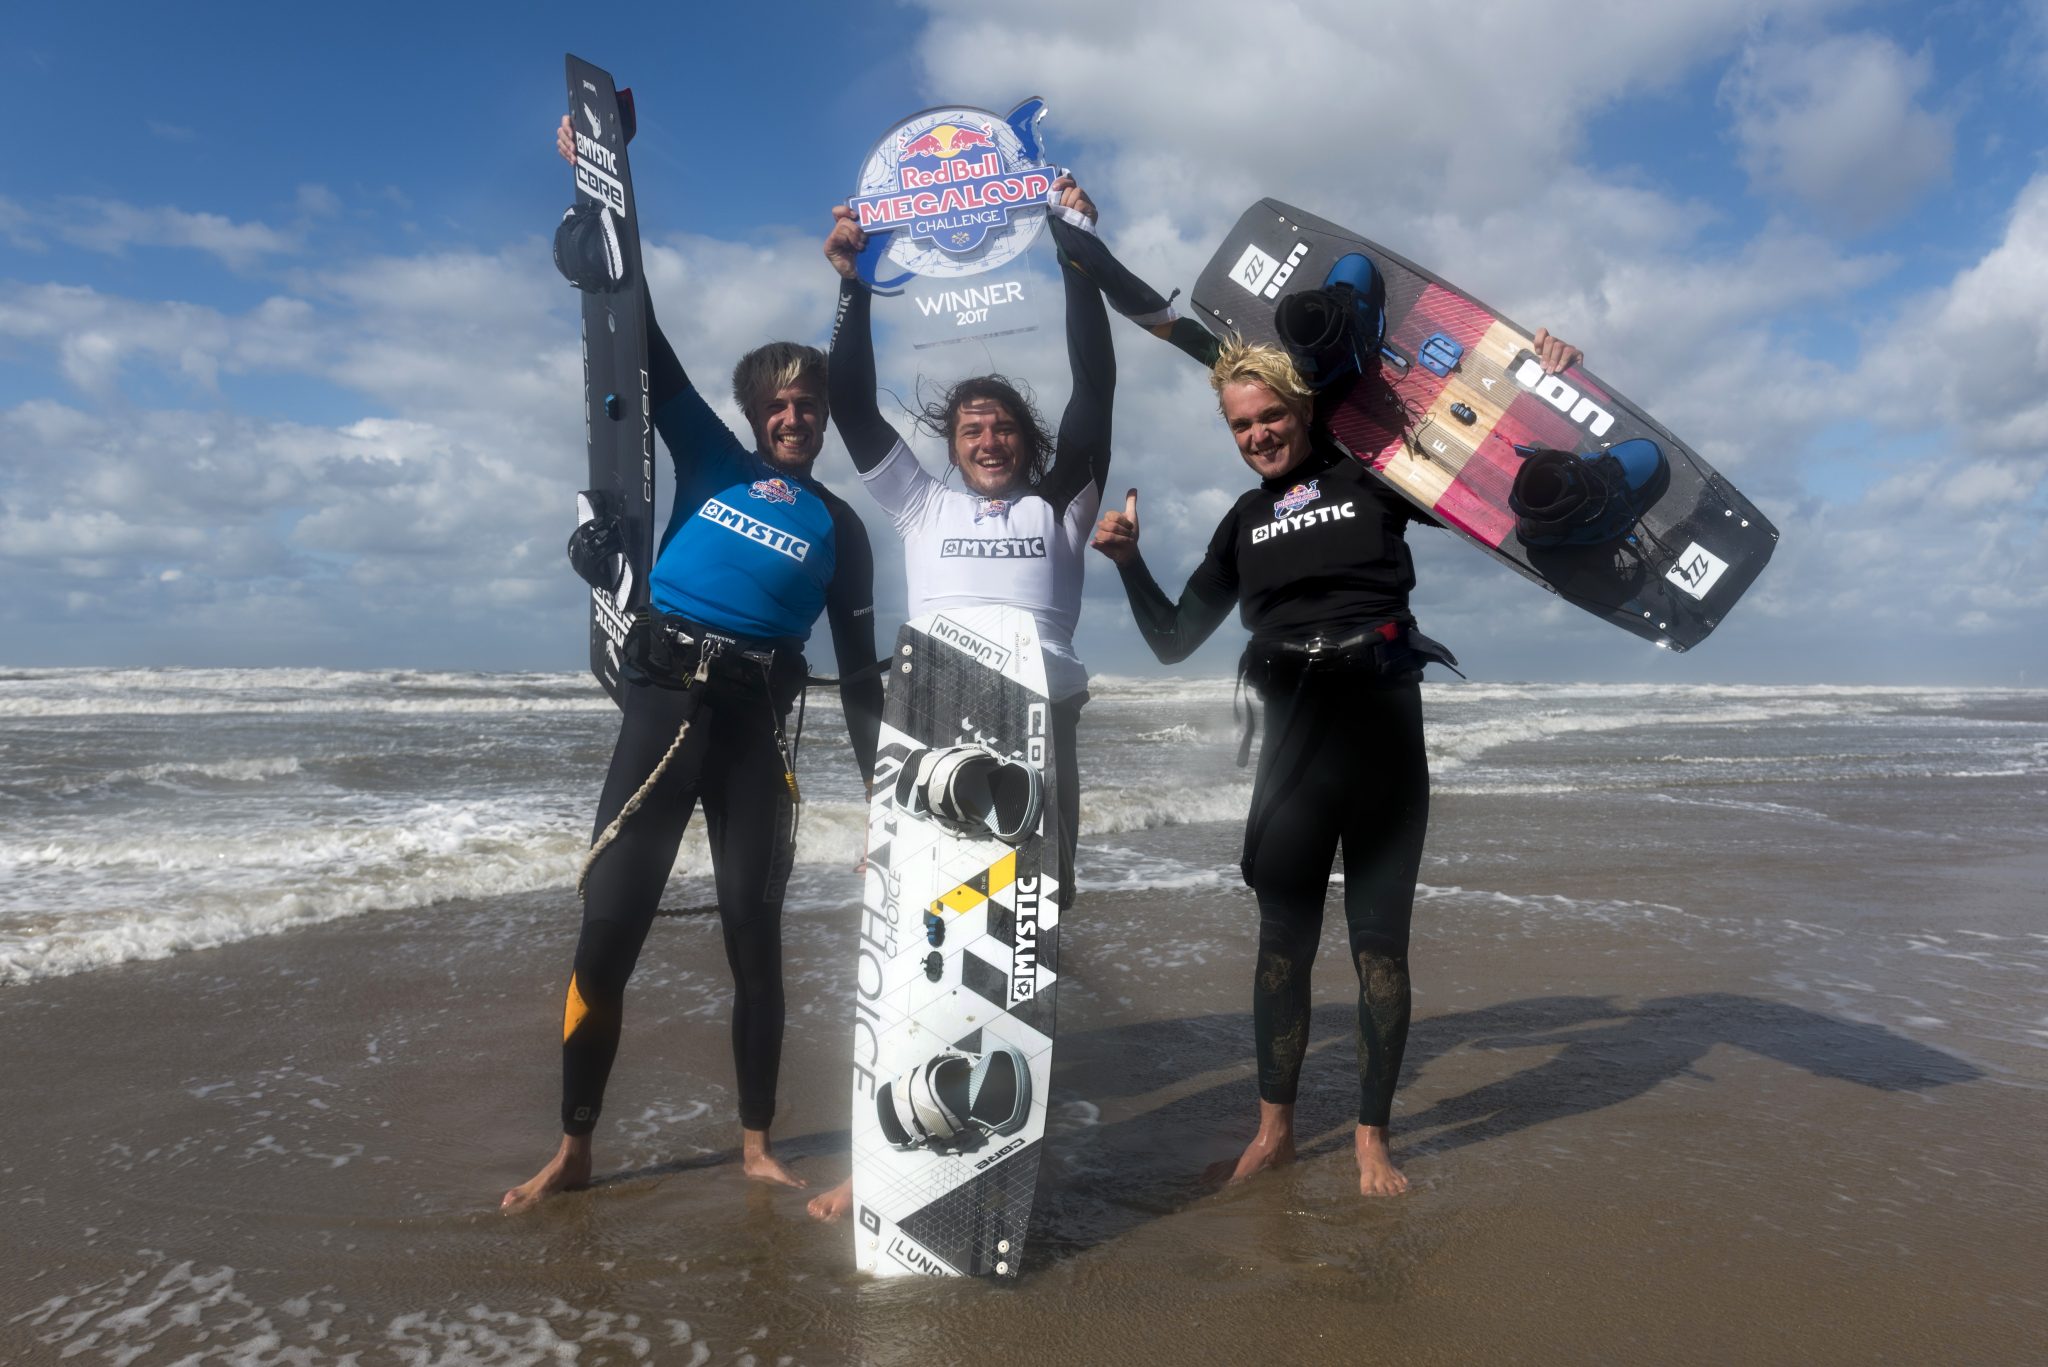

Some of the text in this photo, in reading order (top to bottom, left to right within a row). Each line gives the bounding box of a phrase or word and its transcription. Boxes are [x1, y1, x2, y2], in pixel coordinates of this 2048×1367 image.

[582, 135, 617, 175] MYSTIC
[903, 154, 998, 188] Red Bull
[858, 175, 1049, 226] MEGALOOP
[916, 210, 1001, 233] CHALLENGE
[915, 281, 1025, 317] WINNER
[956, 308, 988, 326] 2017
[718, 511, 806, 559] MYSTIC
[1270, 502, 1356, 538] MYSTIC
[960, 538, 1044, 557] MYSTIC
[595, 604, 625, 649] MYSTIC
[711, 633, 736, 645] MYSTIC
[935, 621, 1004, 667] LUNDUN
[885, 869, 901, 959] CHOICE
[1014, 877, 1038, 976] MYSTIC
[895, 1239, 949, 1277] LUND
